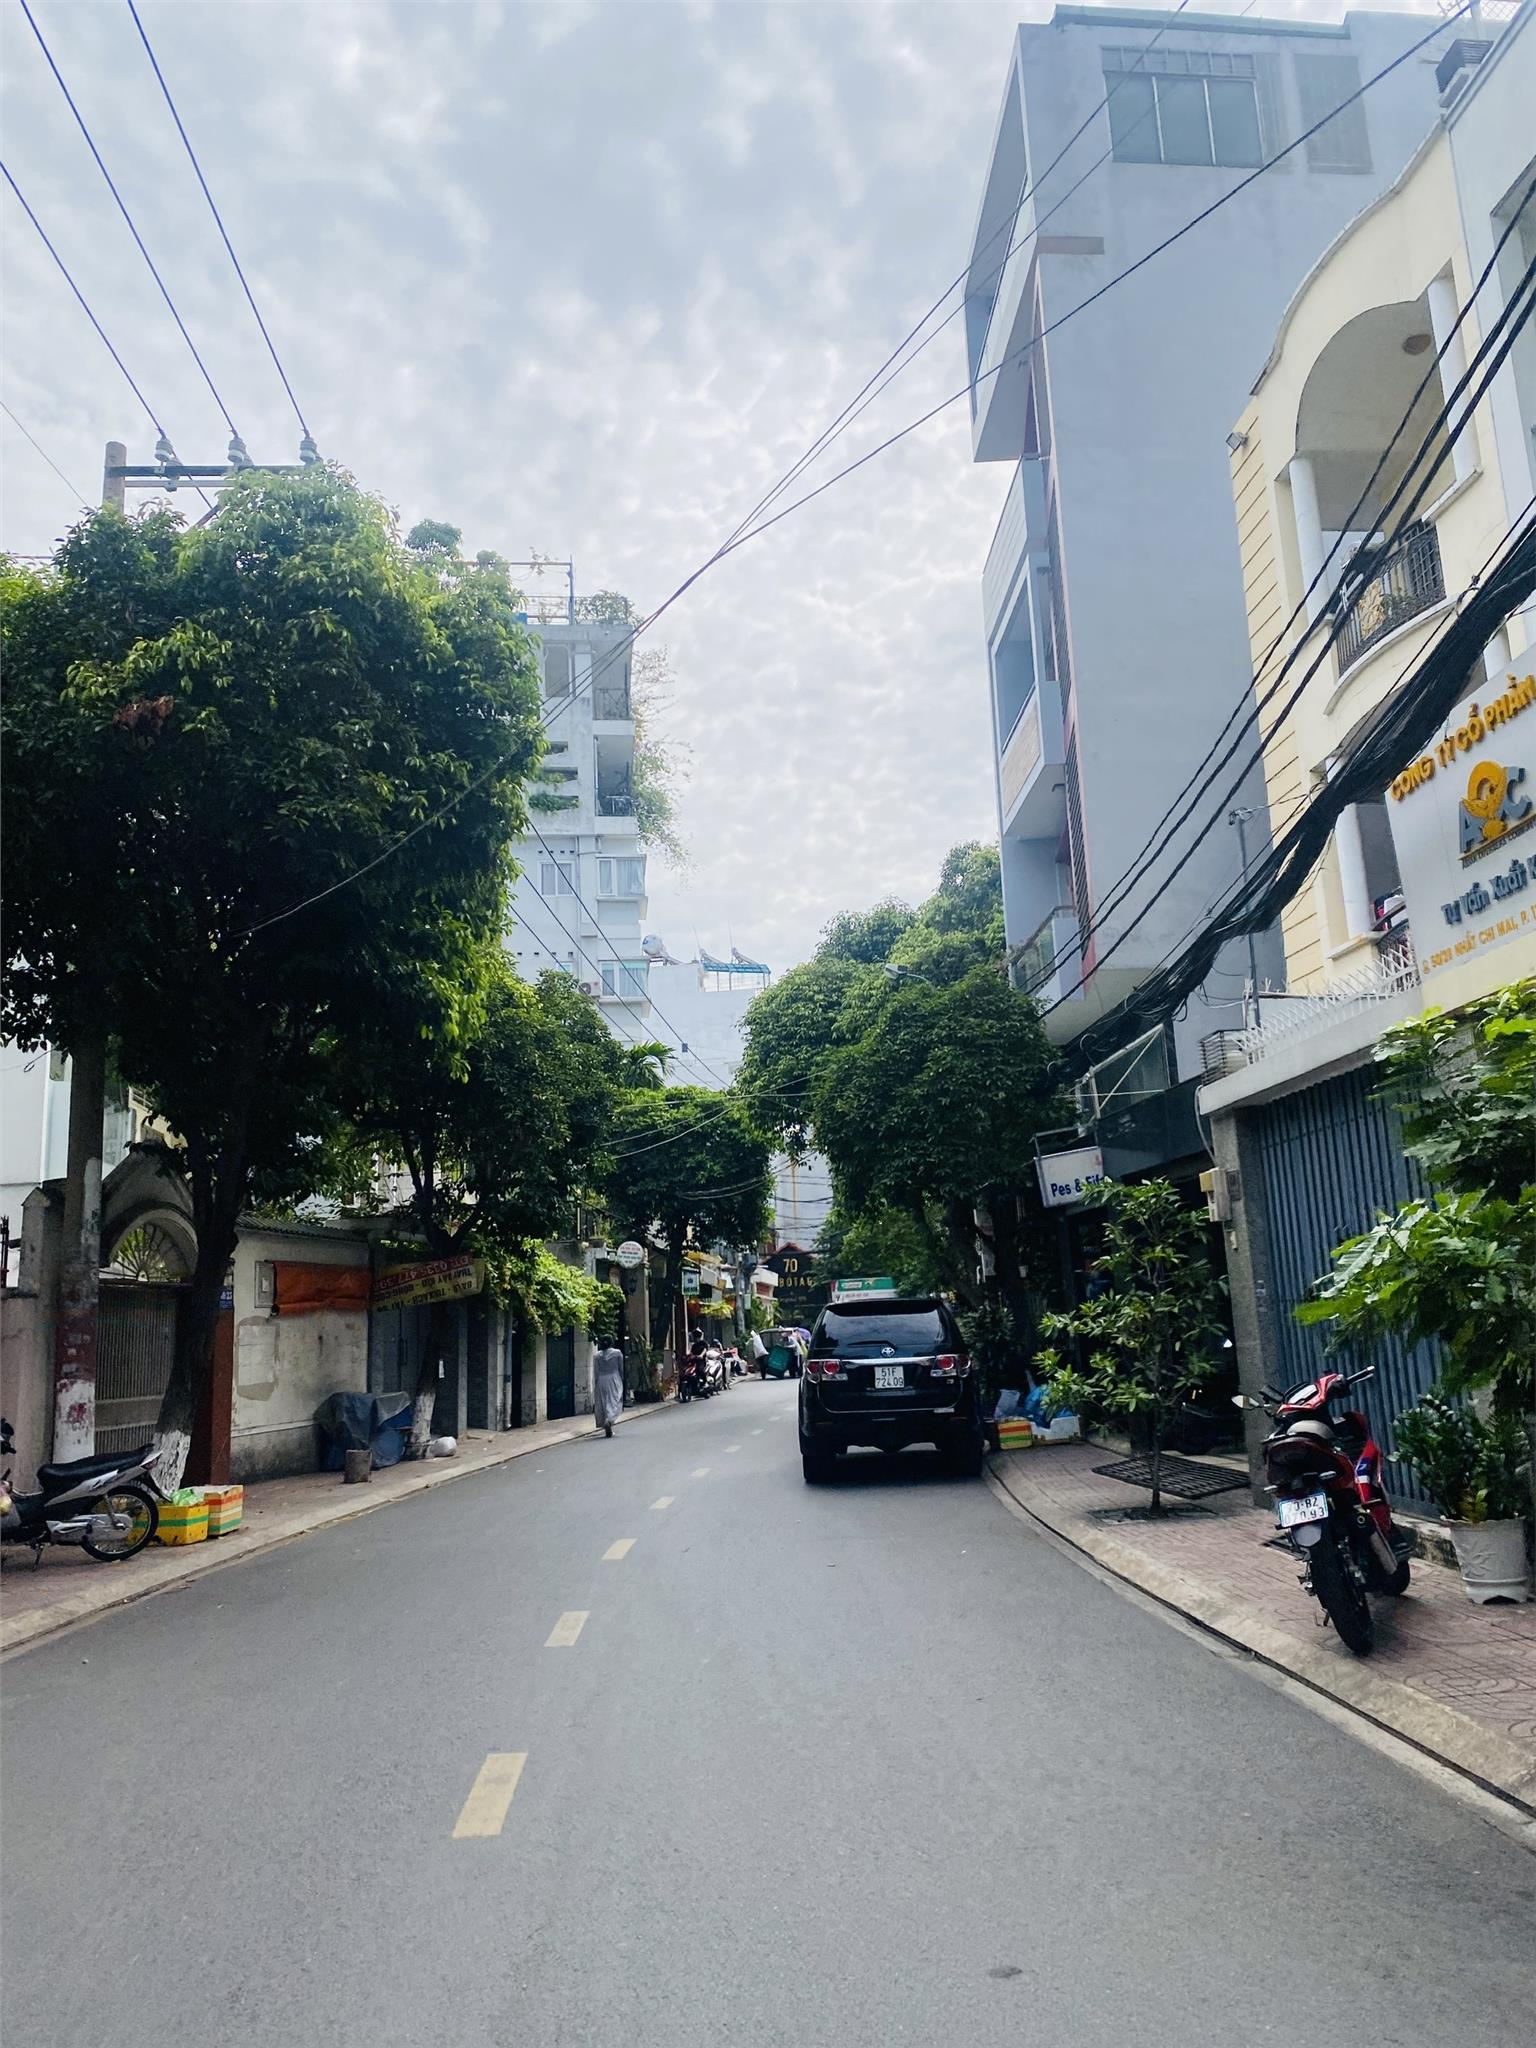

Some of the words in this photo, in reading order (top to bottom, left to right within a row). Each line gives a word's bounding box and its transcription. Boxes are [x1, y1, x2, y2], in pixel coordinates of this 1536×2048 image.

[1050, 1183, 1072, 1200] Pes
[783, 1258, 798, 1273] 70
[881, 1367, 897, 1377] 51F
